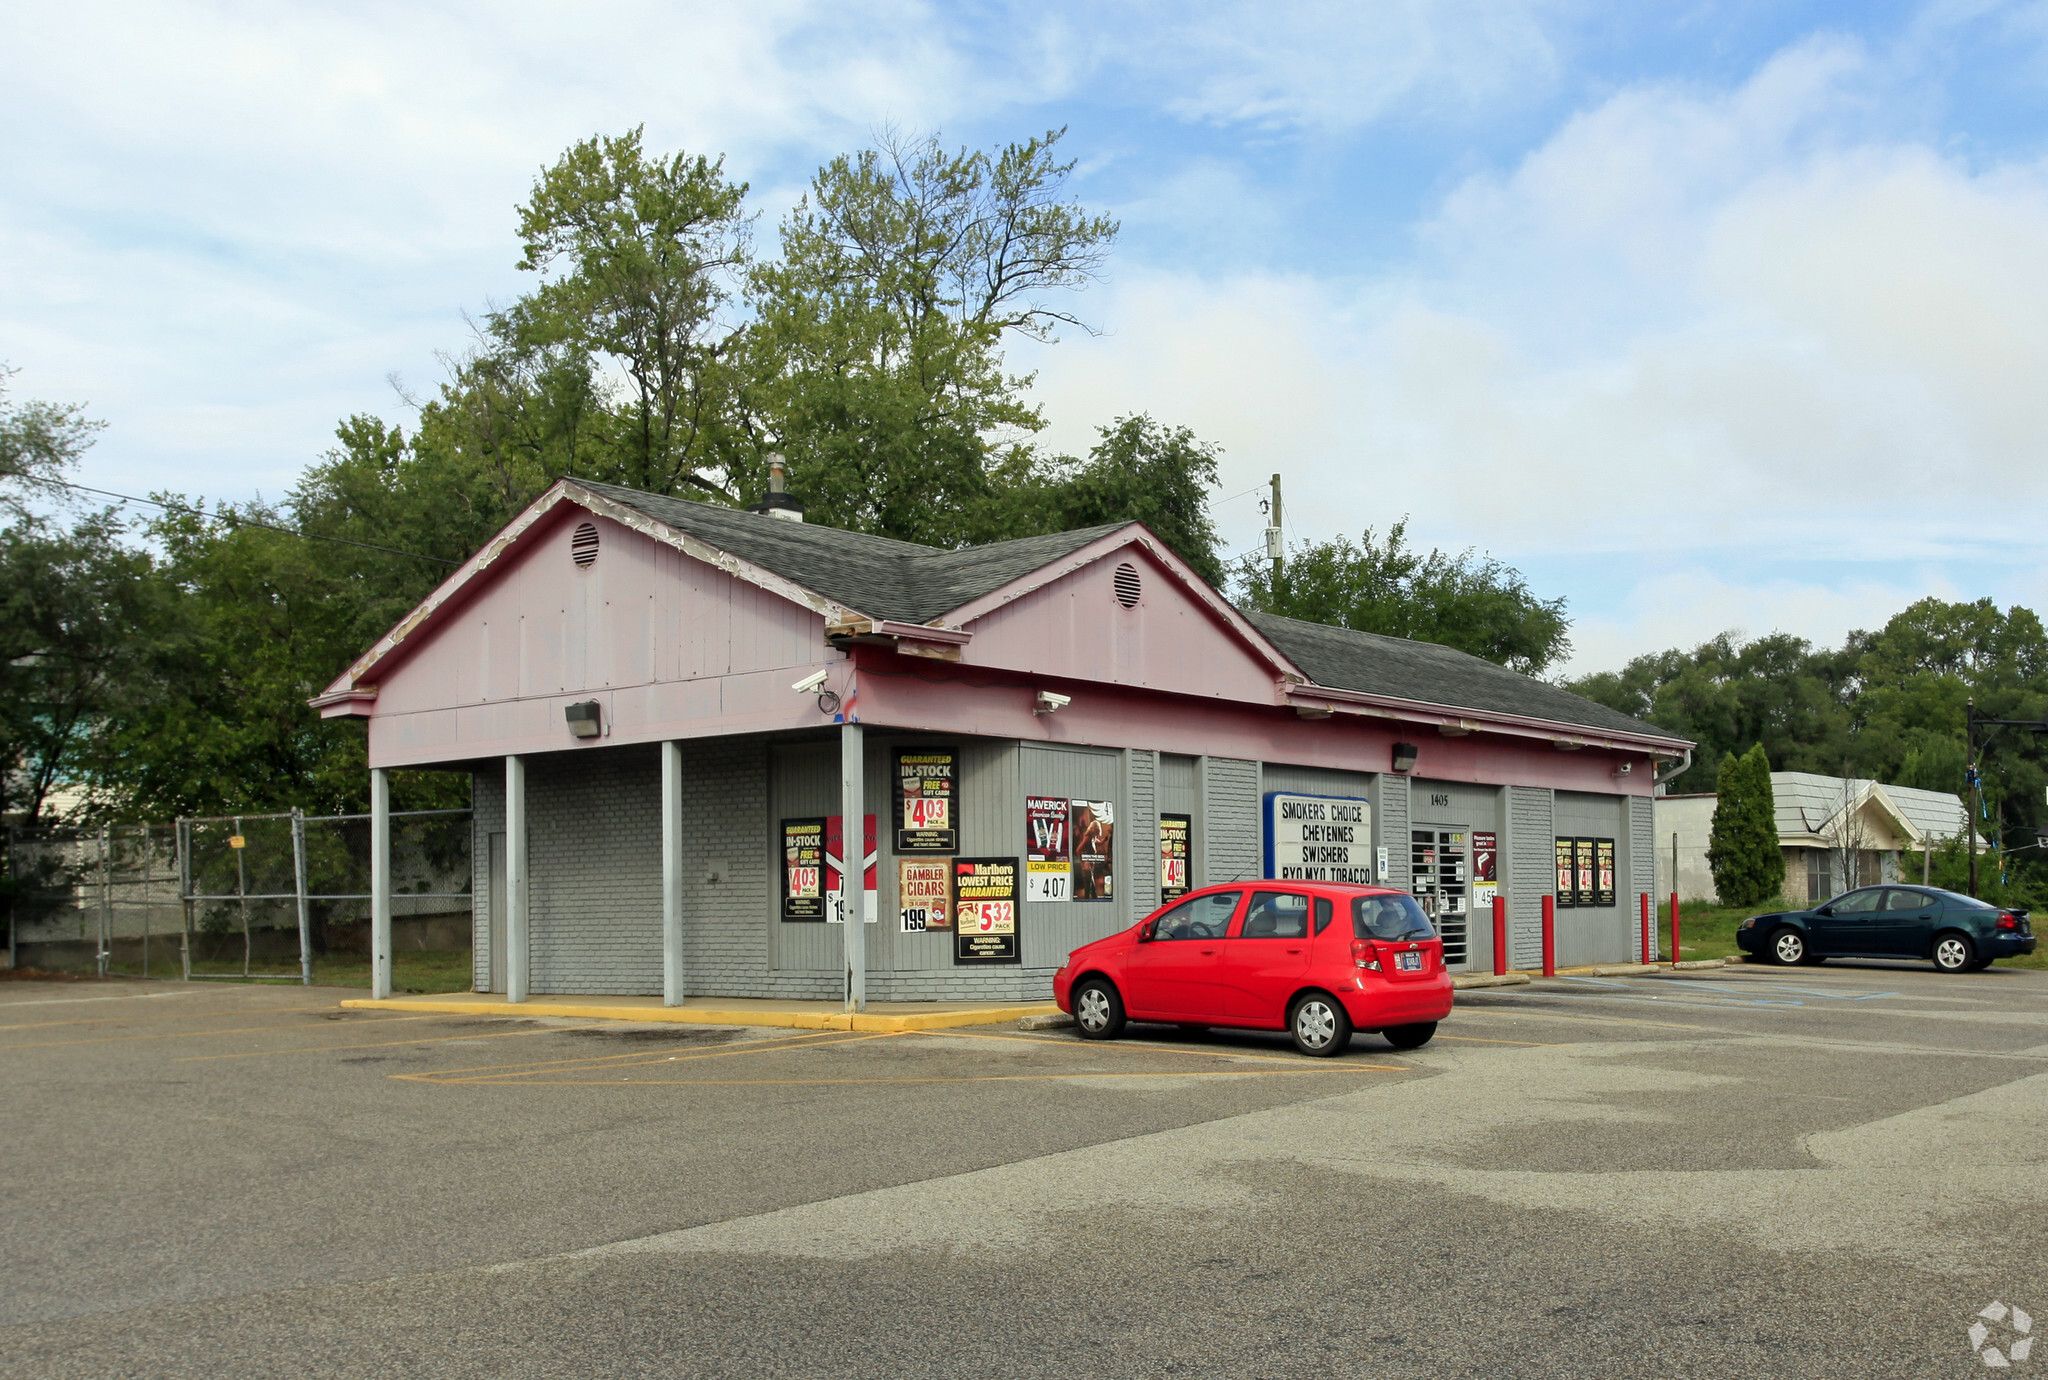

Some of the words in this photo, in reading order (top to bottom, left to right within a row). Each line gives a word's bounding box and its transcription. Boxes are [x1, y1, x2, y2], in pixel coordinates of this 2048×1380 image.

[900, 755, 952, 763] GUARANTEED
[901, 765, 951, 777] IN-STOCK
[923, 780, 941, 790] FREE
[1027, 800, 1067, 810] MAVERICK
[1431, 794, 1448, 806] 1405
[1282, 802, 1326, 820] SMOKERS
[1331, 805, 1362, 822] CHOICE
[786, 825, 821, 834] GUARANTEED
[1160, 829, 1186, 840] IN-STOCK
[1302, 824, 1354, 842] CHEYENNES
[786, 835, 820, 847] IN-STOCK
[800, 850, 813, 859] FREE
[1302, 846, 1349, 863] SWISHERS
[974, 864, 1013, 875] Marlboro
[1047, 863, 1067, 871] PRICE
[906, 869, 944, 880] GAMBLER
[1330, 868, 1370, 884] TOBACCO
[957, 876, 988, 887] LOWEST
[990, 876, 1014, 886] PRICE
[907, 881, 944, 896] CIGARS
[960, 886, 1013, 897] GUARANTEED!
[902, 909, 926, 930] 199
